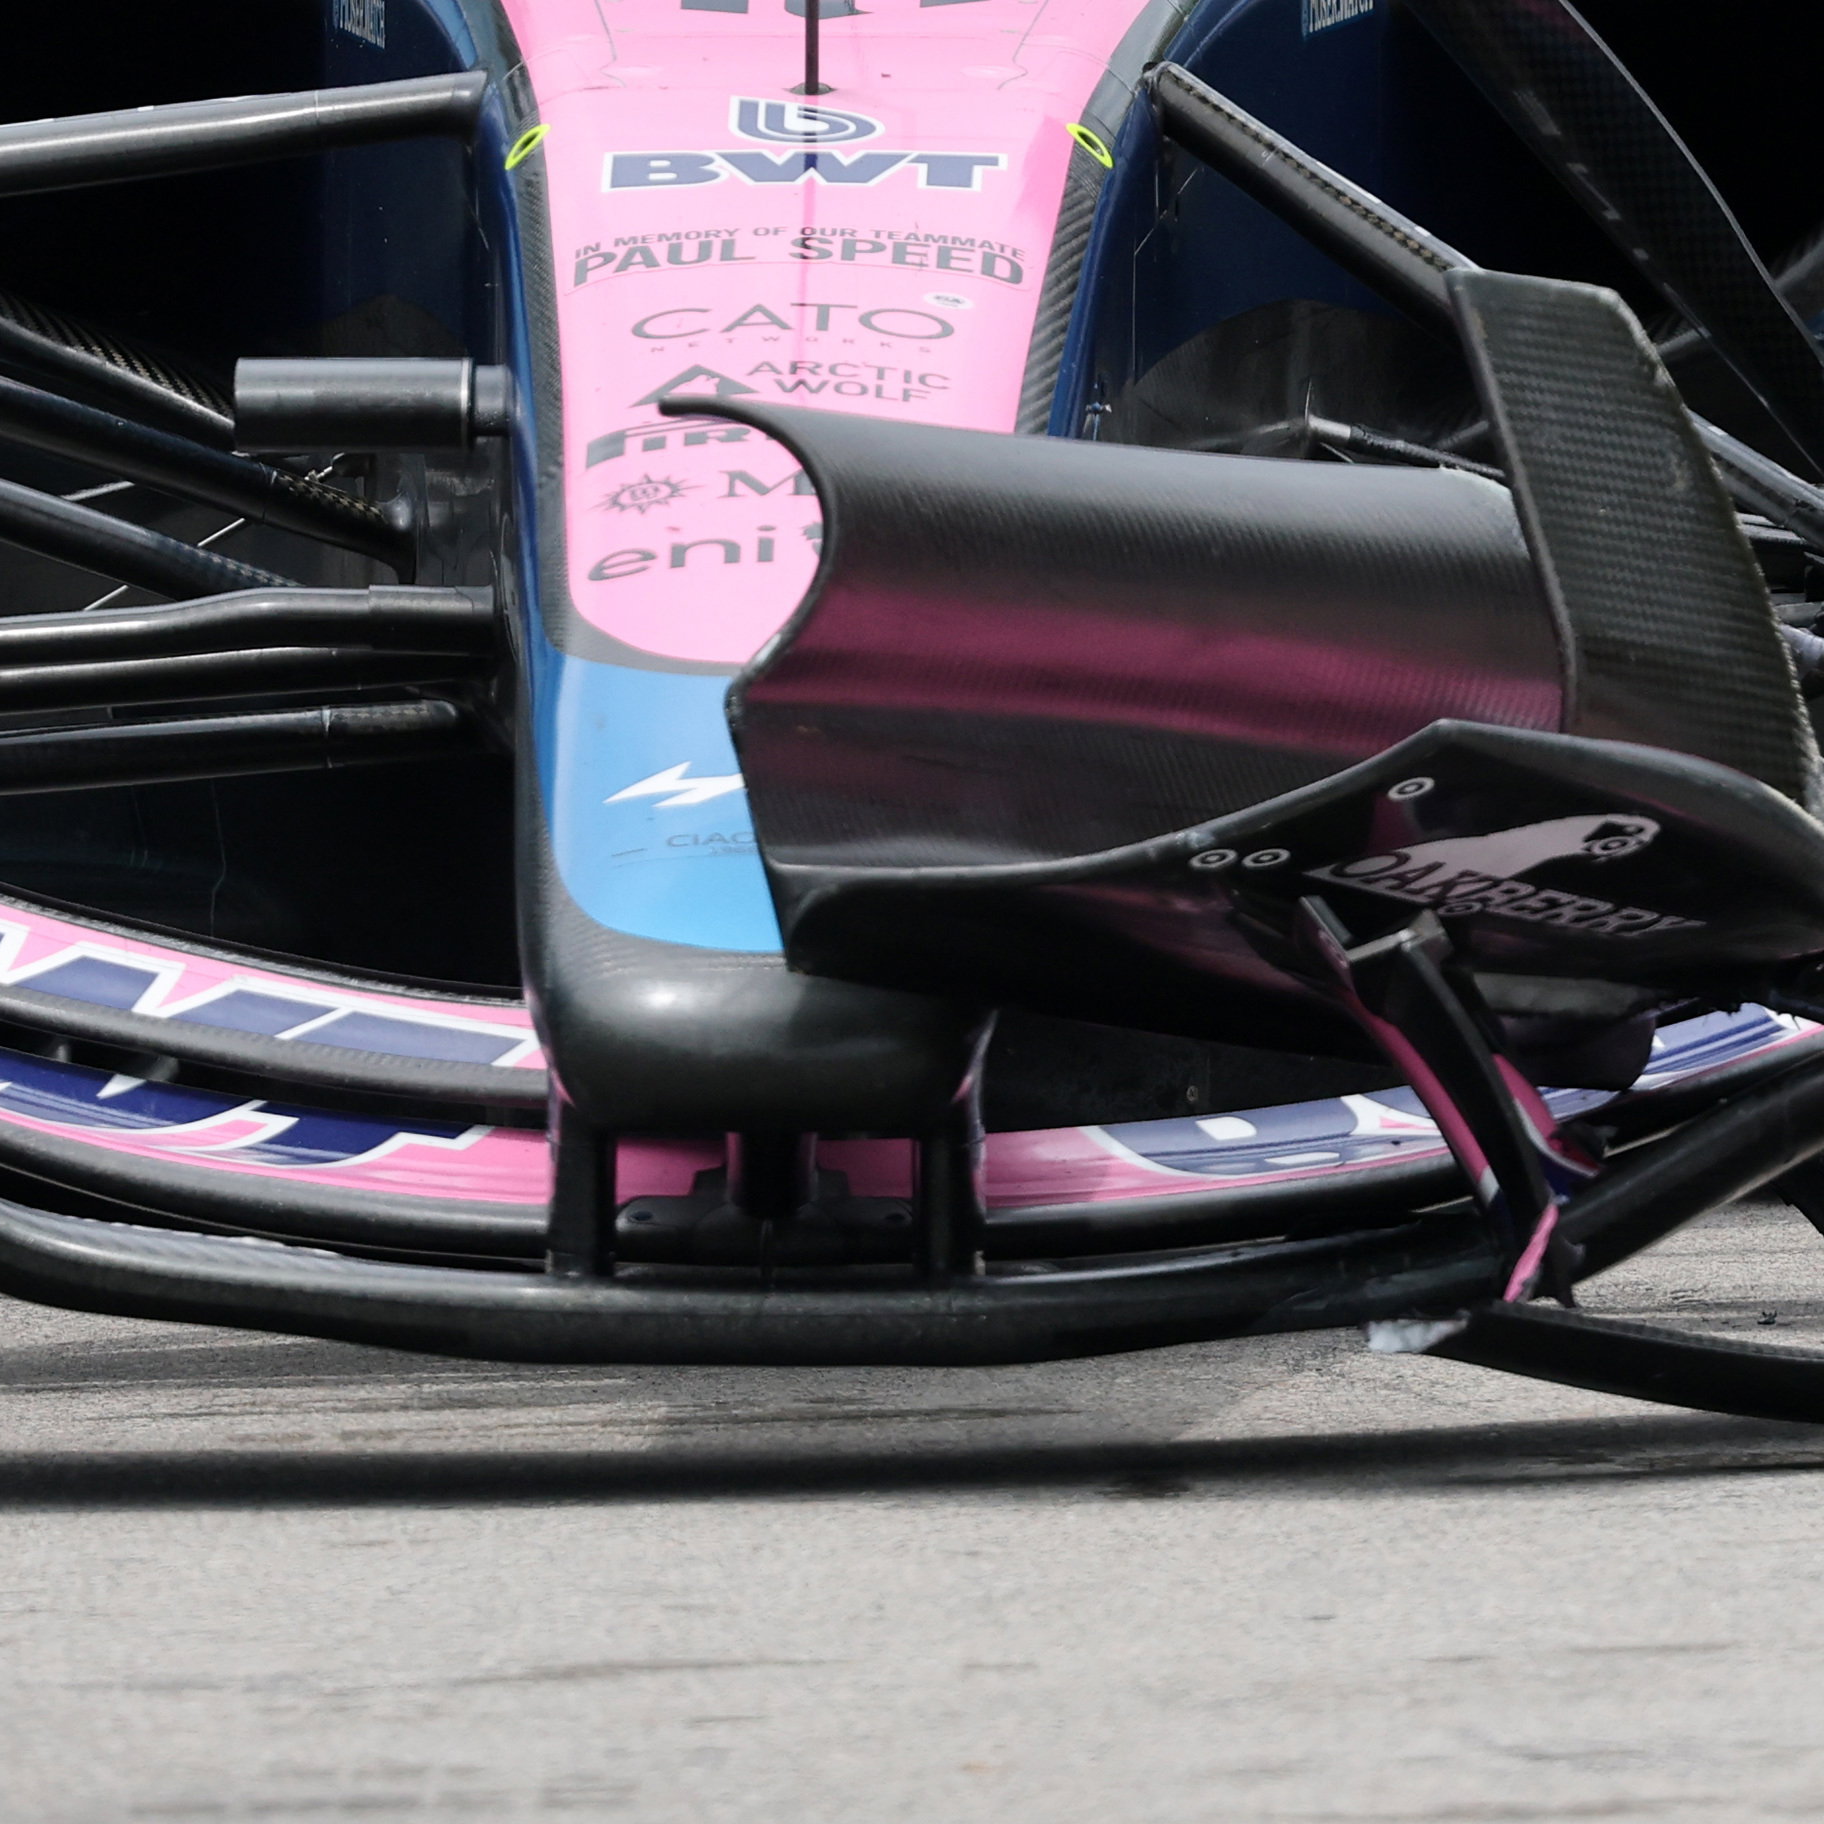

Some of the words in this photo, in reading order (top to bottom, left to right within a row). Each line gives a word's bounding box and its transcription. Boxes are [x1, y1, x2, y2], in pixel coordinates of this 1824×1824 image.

[606, 150, 1004, 191] BWT
[573, 239, 757, 289] PAUL
[788, 236, 1024, 286] SPEED
[574, 241, 601, 259] IN
[613, 227, 740, 248] MEMORY
[752, 225, 788, 238] OF
[799, 226, 859, 239] OUR
[872, 228, 1025, 261] TEAMMATE
[630, 303, 955, 340] CATO
[745, 359, 952, 390] ARCTIC
[773, 377, 934, 404] WOLF
[587, 524, 776, 582] eni
[1329, 850, 1707, 938] OAKBERRY
